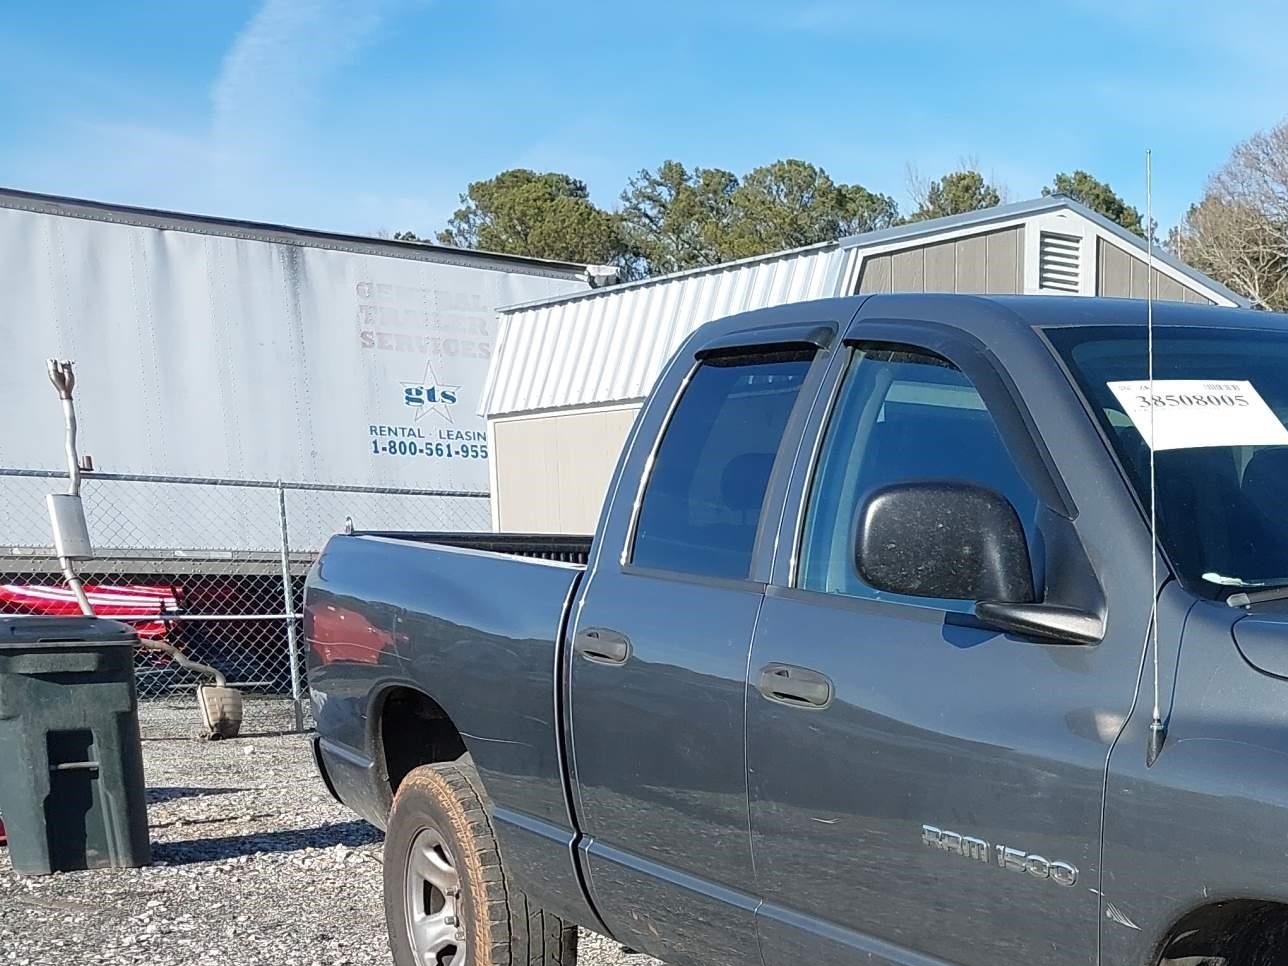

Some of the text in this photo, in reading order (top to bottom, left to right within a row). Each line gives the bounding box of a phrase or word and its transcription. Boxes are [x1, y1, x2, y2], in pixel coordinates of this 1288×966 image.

[360, 330, 491, 360] SERVICES
[404, 386, 457, 407] gts
[1136, 394, 1249, 408] 38508005
[369, 425, 425, 439] RENTAL
[995, 844, 1079, 887] 1500
